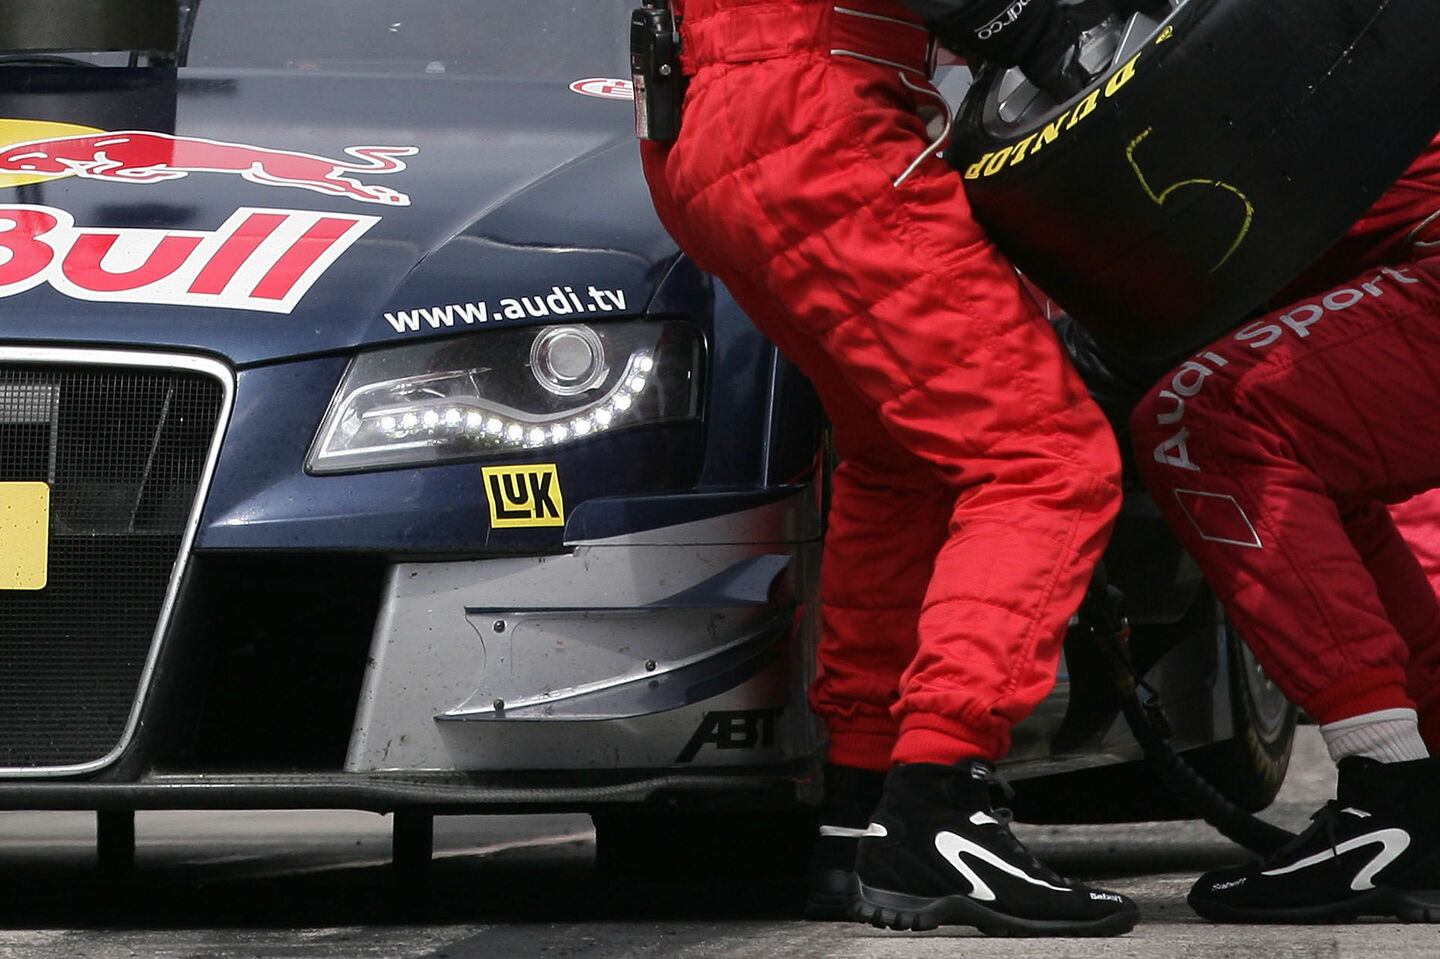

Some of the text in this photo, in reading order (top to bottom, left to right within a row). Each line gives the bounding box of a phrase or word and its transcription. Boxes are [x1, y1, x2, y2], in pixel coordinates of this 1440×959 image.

[964, 52, 1142, 179] DUNLOP
[1126, 126, 1254, 273] 5
[383, 286, 628, 333] www.audi.tv
[1153, 266, 1419, 473] Audi Sport
[675, 707, 783, 762] ABT
